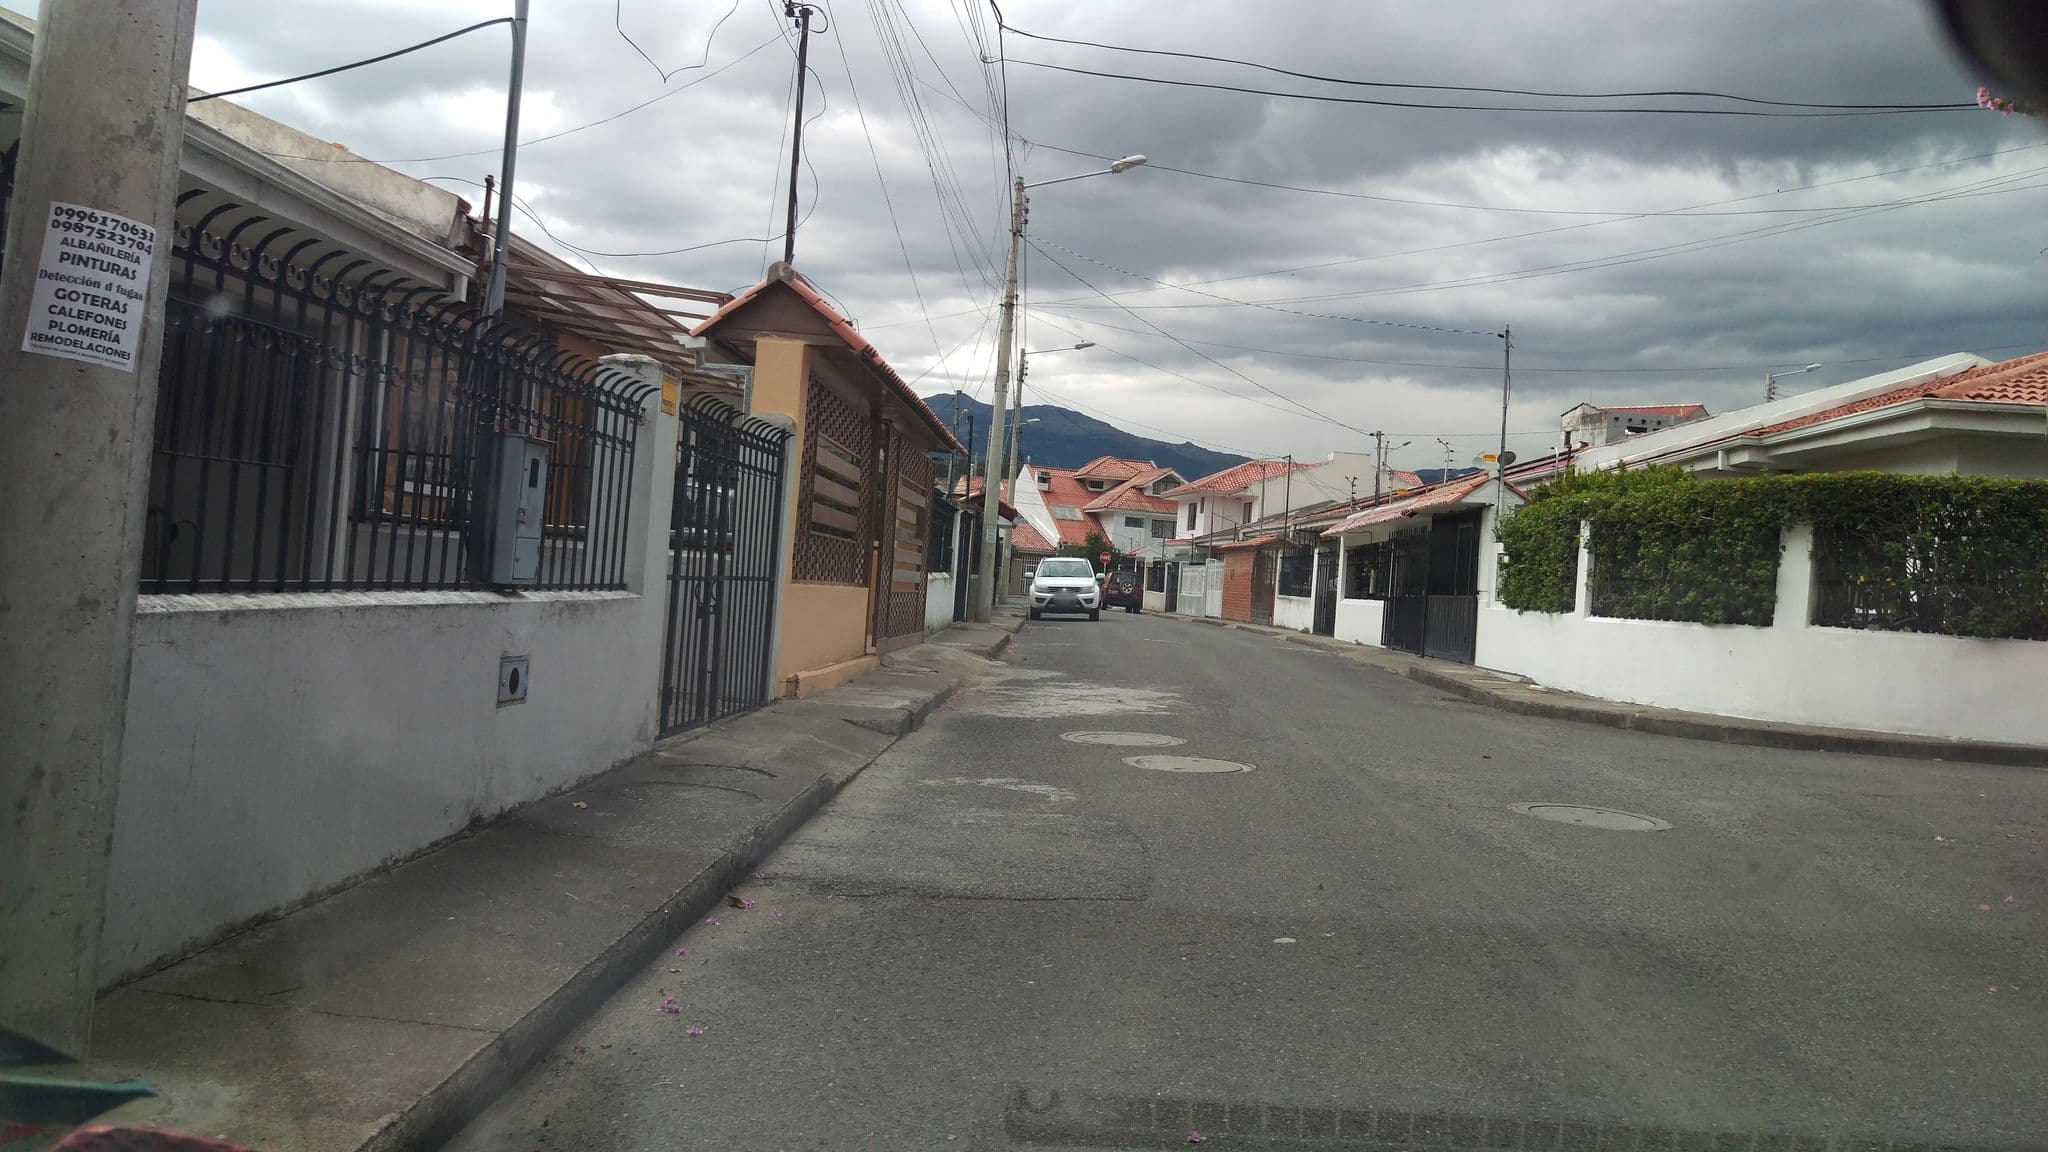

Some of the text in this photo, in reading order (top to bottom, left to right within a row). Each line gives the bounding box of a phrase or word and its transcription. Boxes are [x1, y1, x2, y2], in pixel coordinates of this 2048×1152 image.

[51, 219, 152, 255] 0987523704
[54, 206, 154, 242] 0996170631
[60, 236, 141, 265] ALBAÑILERÍA
[59, 251, 136, 280] PINTURAS
[39, 269, 144, 302] Detección d fugas
[54, 287, 128, 314] GOTERAS
[48, 304, 127, 330] CALEFONES
[30, 332, 131, 360] REMODELACIONES
[48, 319, 120, 345] PLOMERÍA
